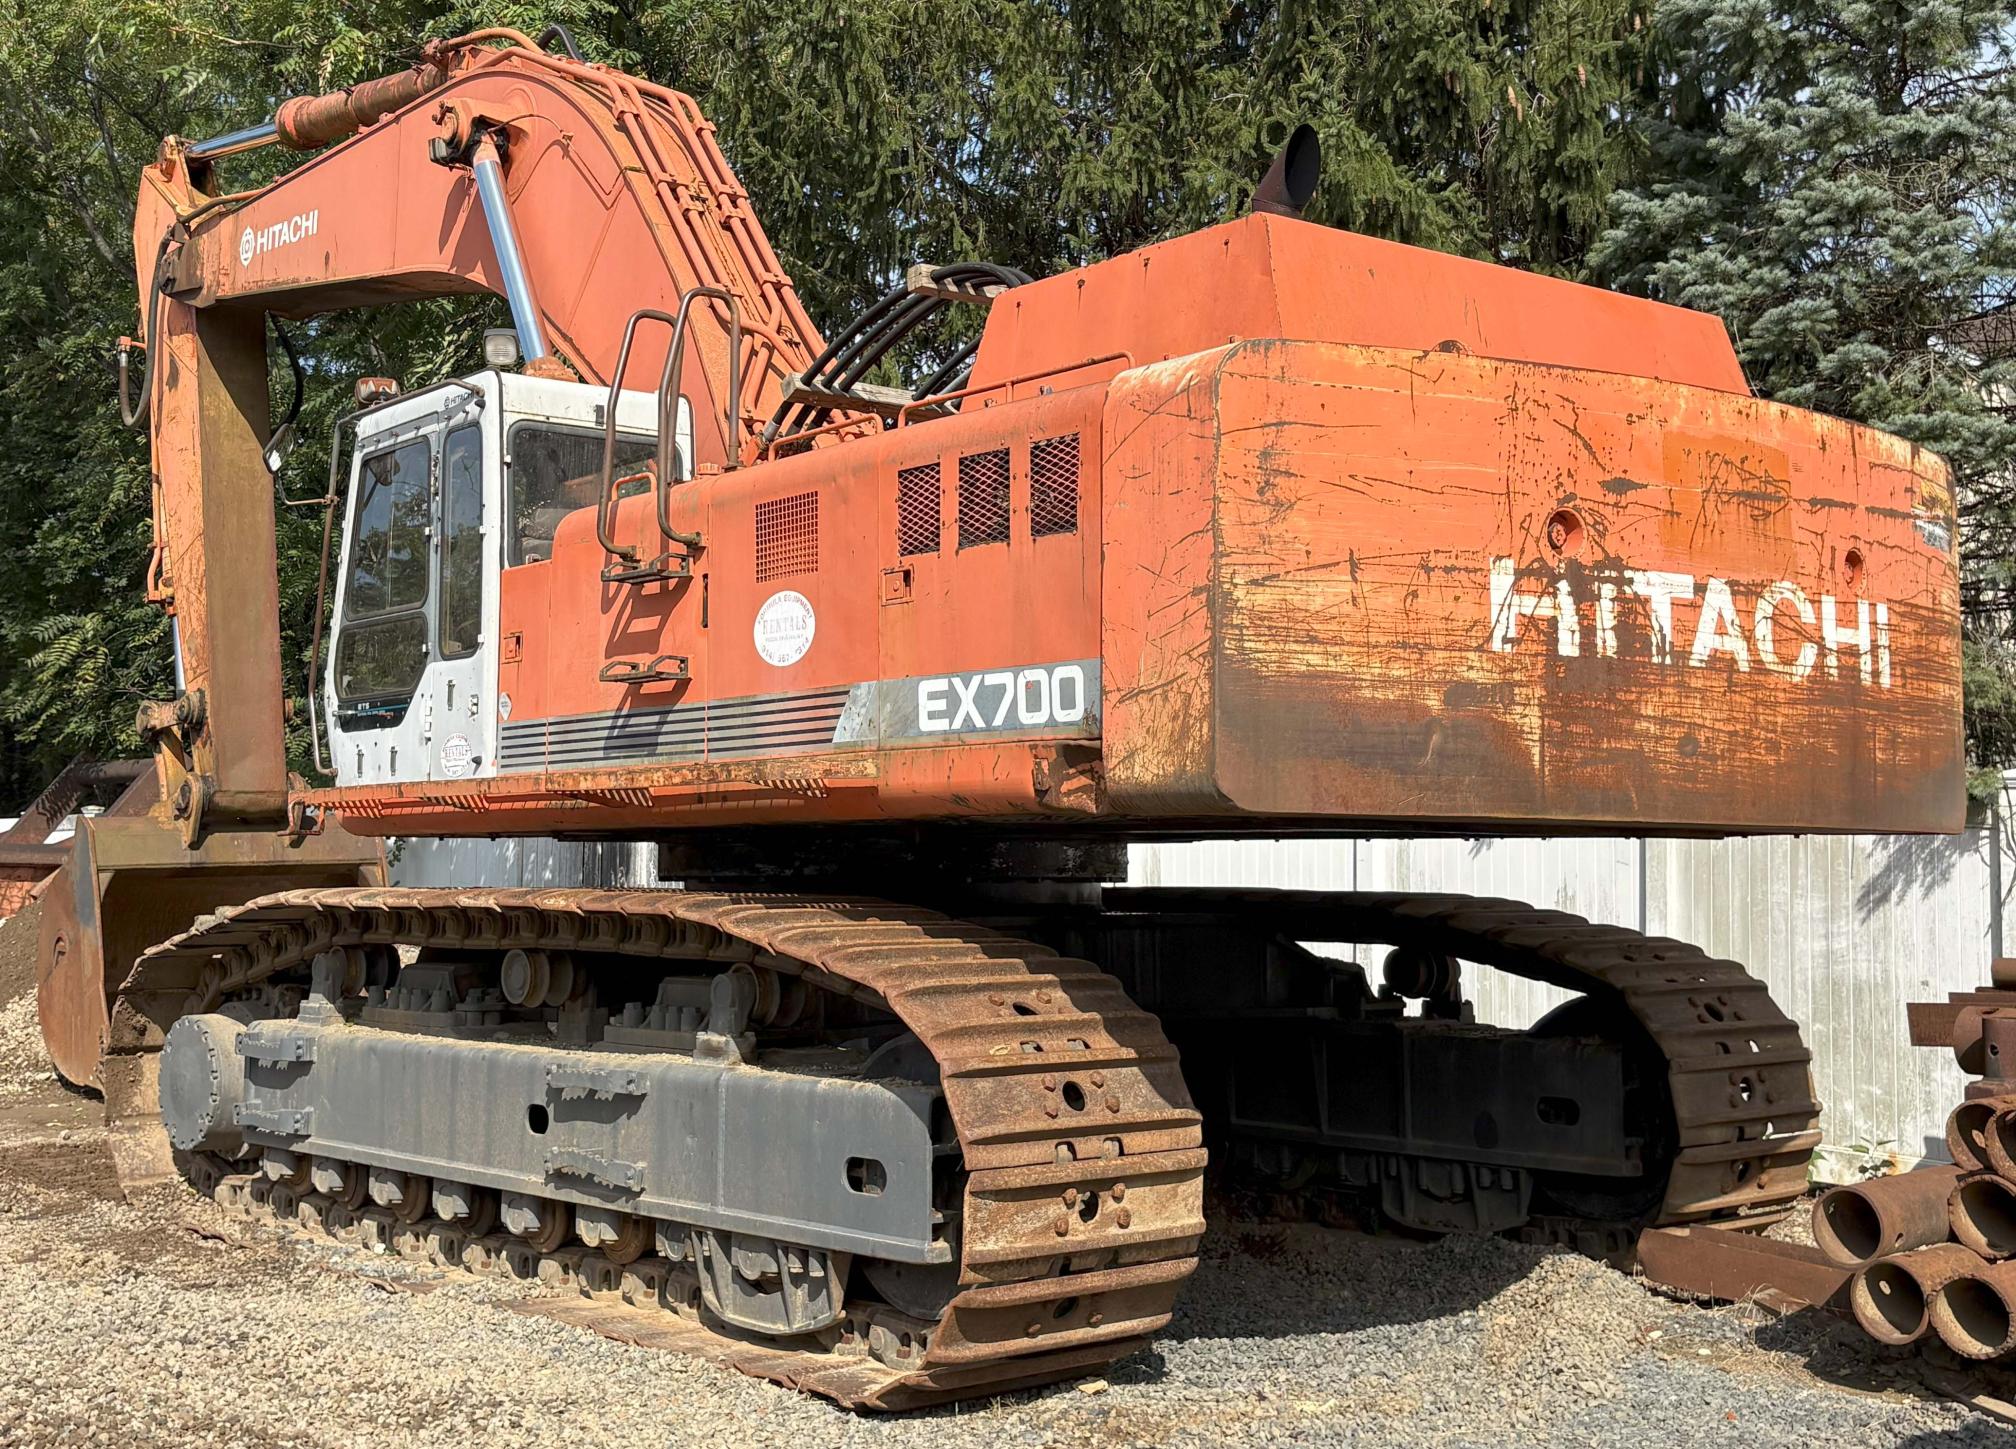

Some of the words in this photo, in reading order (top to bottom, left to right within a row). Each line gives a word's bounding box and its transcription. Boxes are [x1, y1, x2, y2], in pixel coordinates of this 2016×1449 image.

[256, 209, 319, 255] HITACHI
[762, 614, 807, 636] RENTALS
[1489, 557, 1891, 688] HITACHI
[917, 664, 1085, 732] EX700
